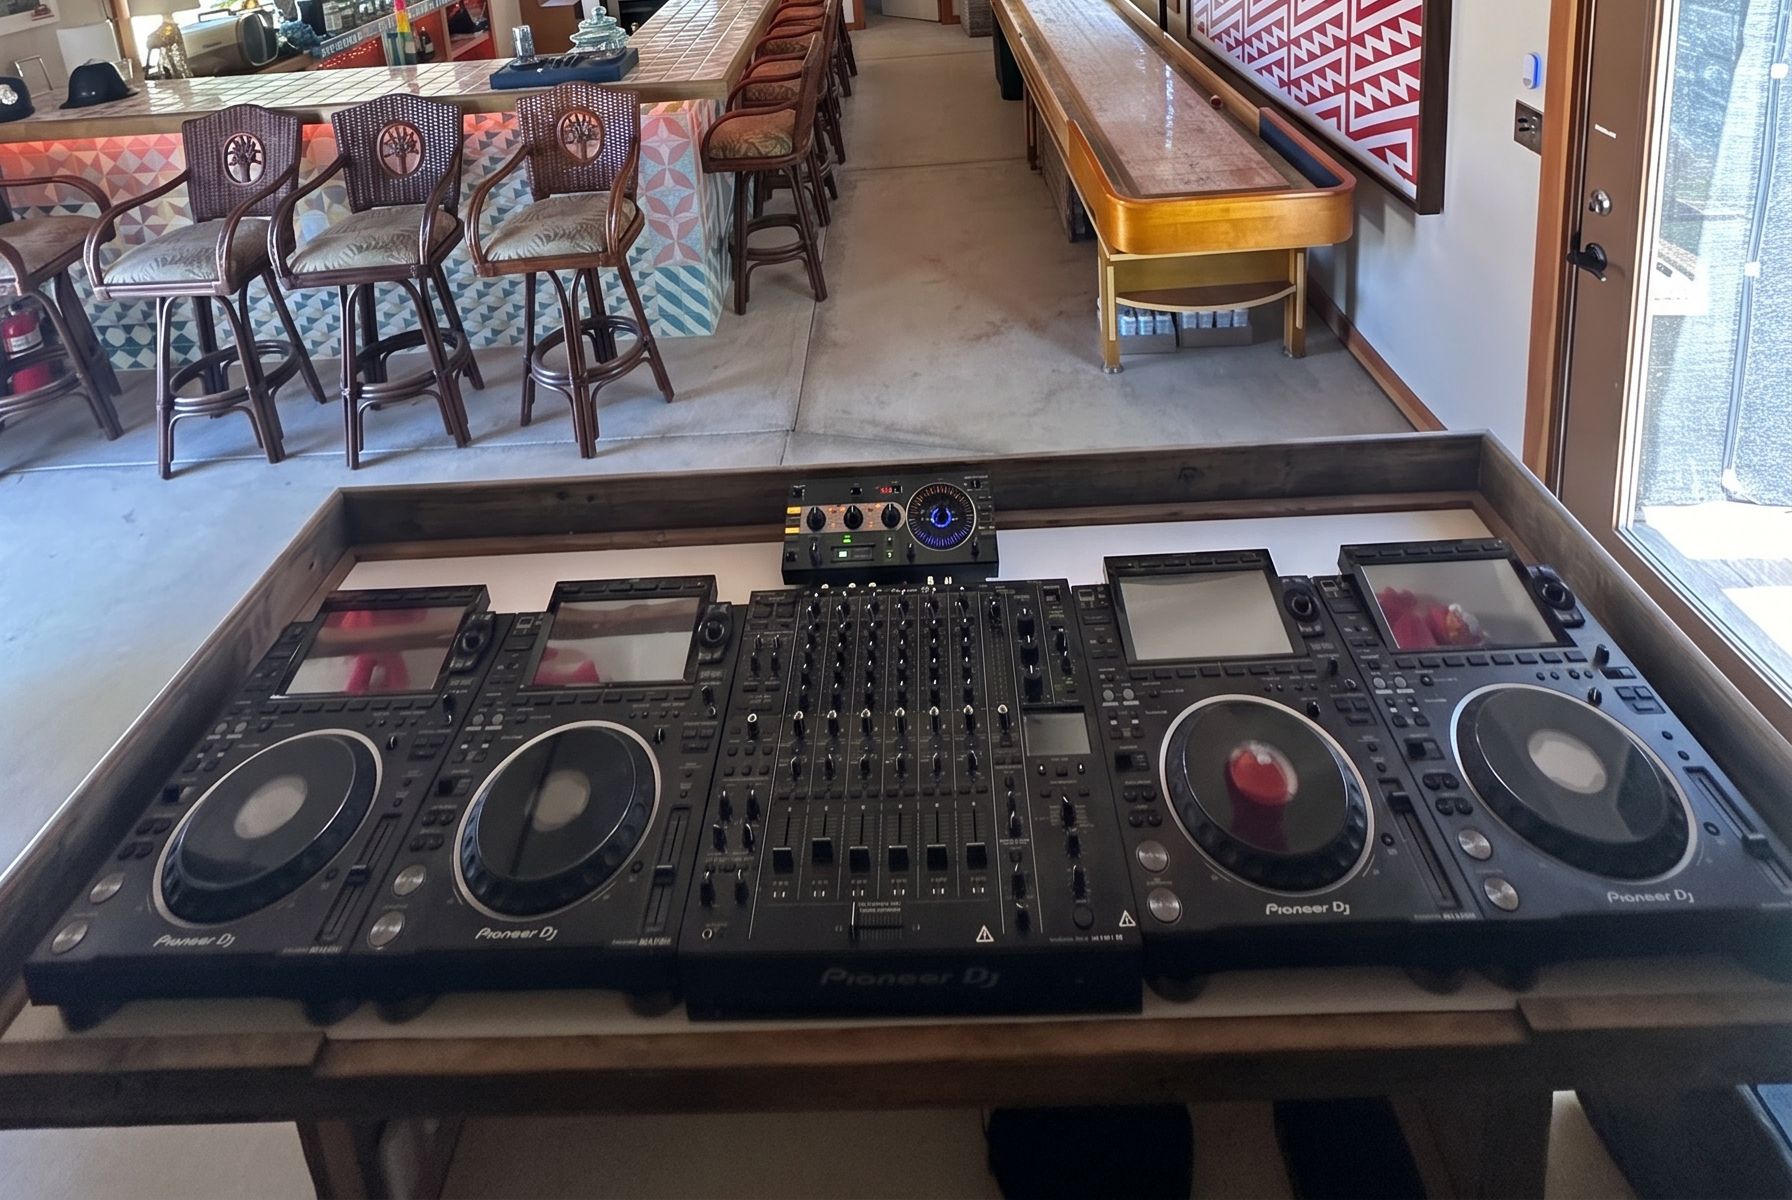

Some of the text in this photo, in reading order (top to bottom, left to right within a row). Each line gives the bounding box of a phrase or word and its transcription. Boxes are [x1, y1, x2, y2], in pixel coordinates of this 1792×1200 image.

[1607, 890, 1671, 904] Pioneer
[1265, 902, 1329, 915] Pioneer
[475, 927, 538, 940] Pioneer
[153, 934, 216, 947] Pioneer
[820, 967, 953, 986] Pioneer
